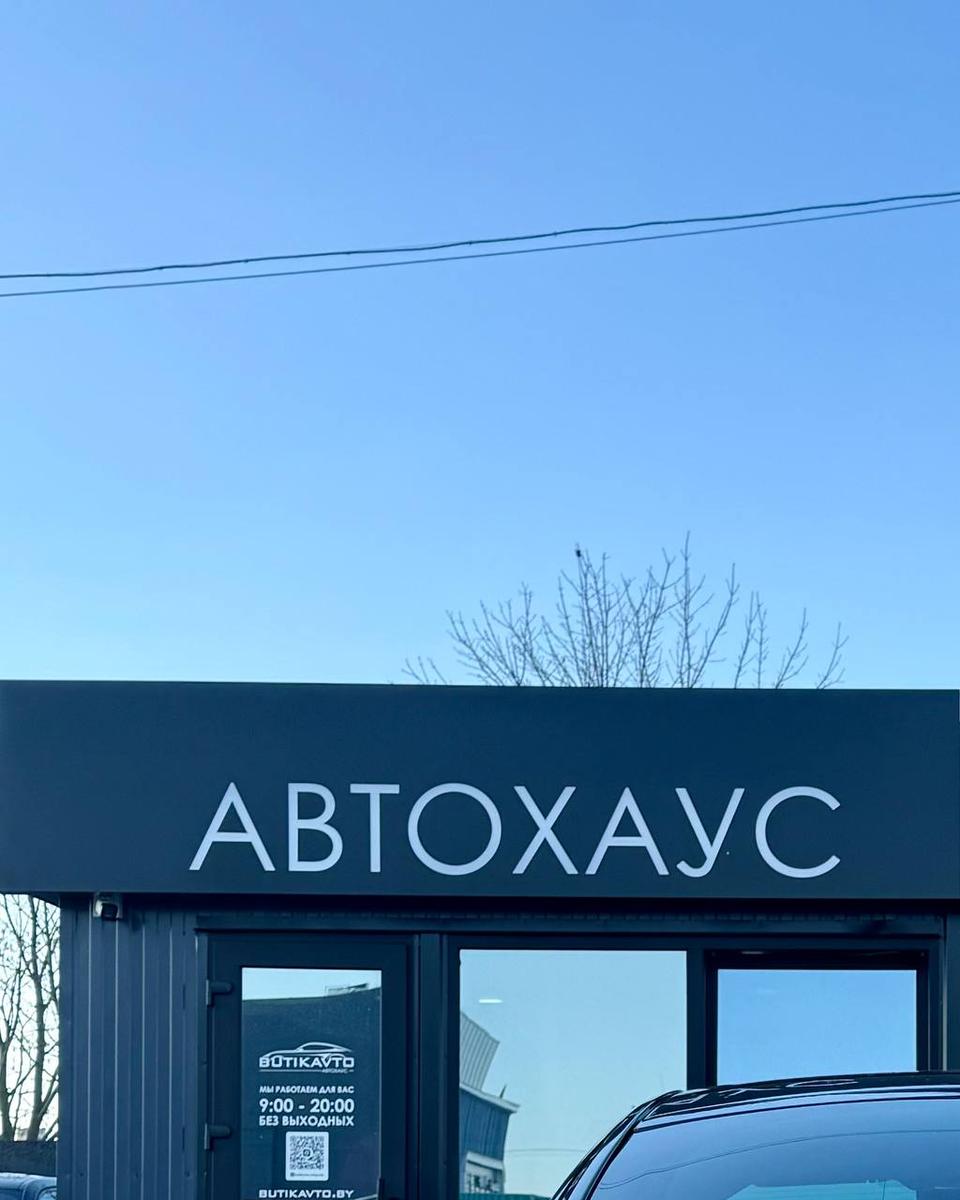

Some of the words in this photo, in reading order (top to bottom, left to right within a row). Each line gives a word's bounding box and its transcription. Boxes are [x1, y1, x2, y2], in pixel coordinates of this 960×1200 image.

[189, 781, 841, 879] АВТОХАУС
[258, 1056, 355, 1068] BUTIKAVTO
[259, 1085, 274, 1094] МЫ
[275, 1085, 318, 1094] РАБОТАЕМ
[319, 1085, 336, 1095] ДЛЯ
[337, 1085, 355, 1094] ВАС
[259, 1098, 294, 1113] 9:00
[309, 1098, 355, 1113] 20:00
[258, 1115, 279, 1127] БЕЗ
[282, 1115, 355, 1127] ВЫХОДНЫХ
[258, 1189, 354, 1199] BUTIKAVTO.BY
